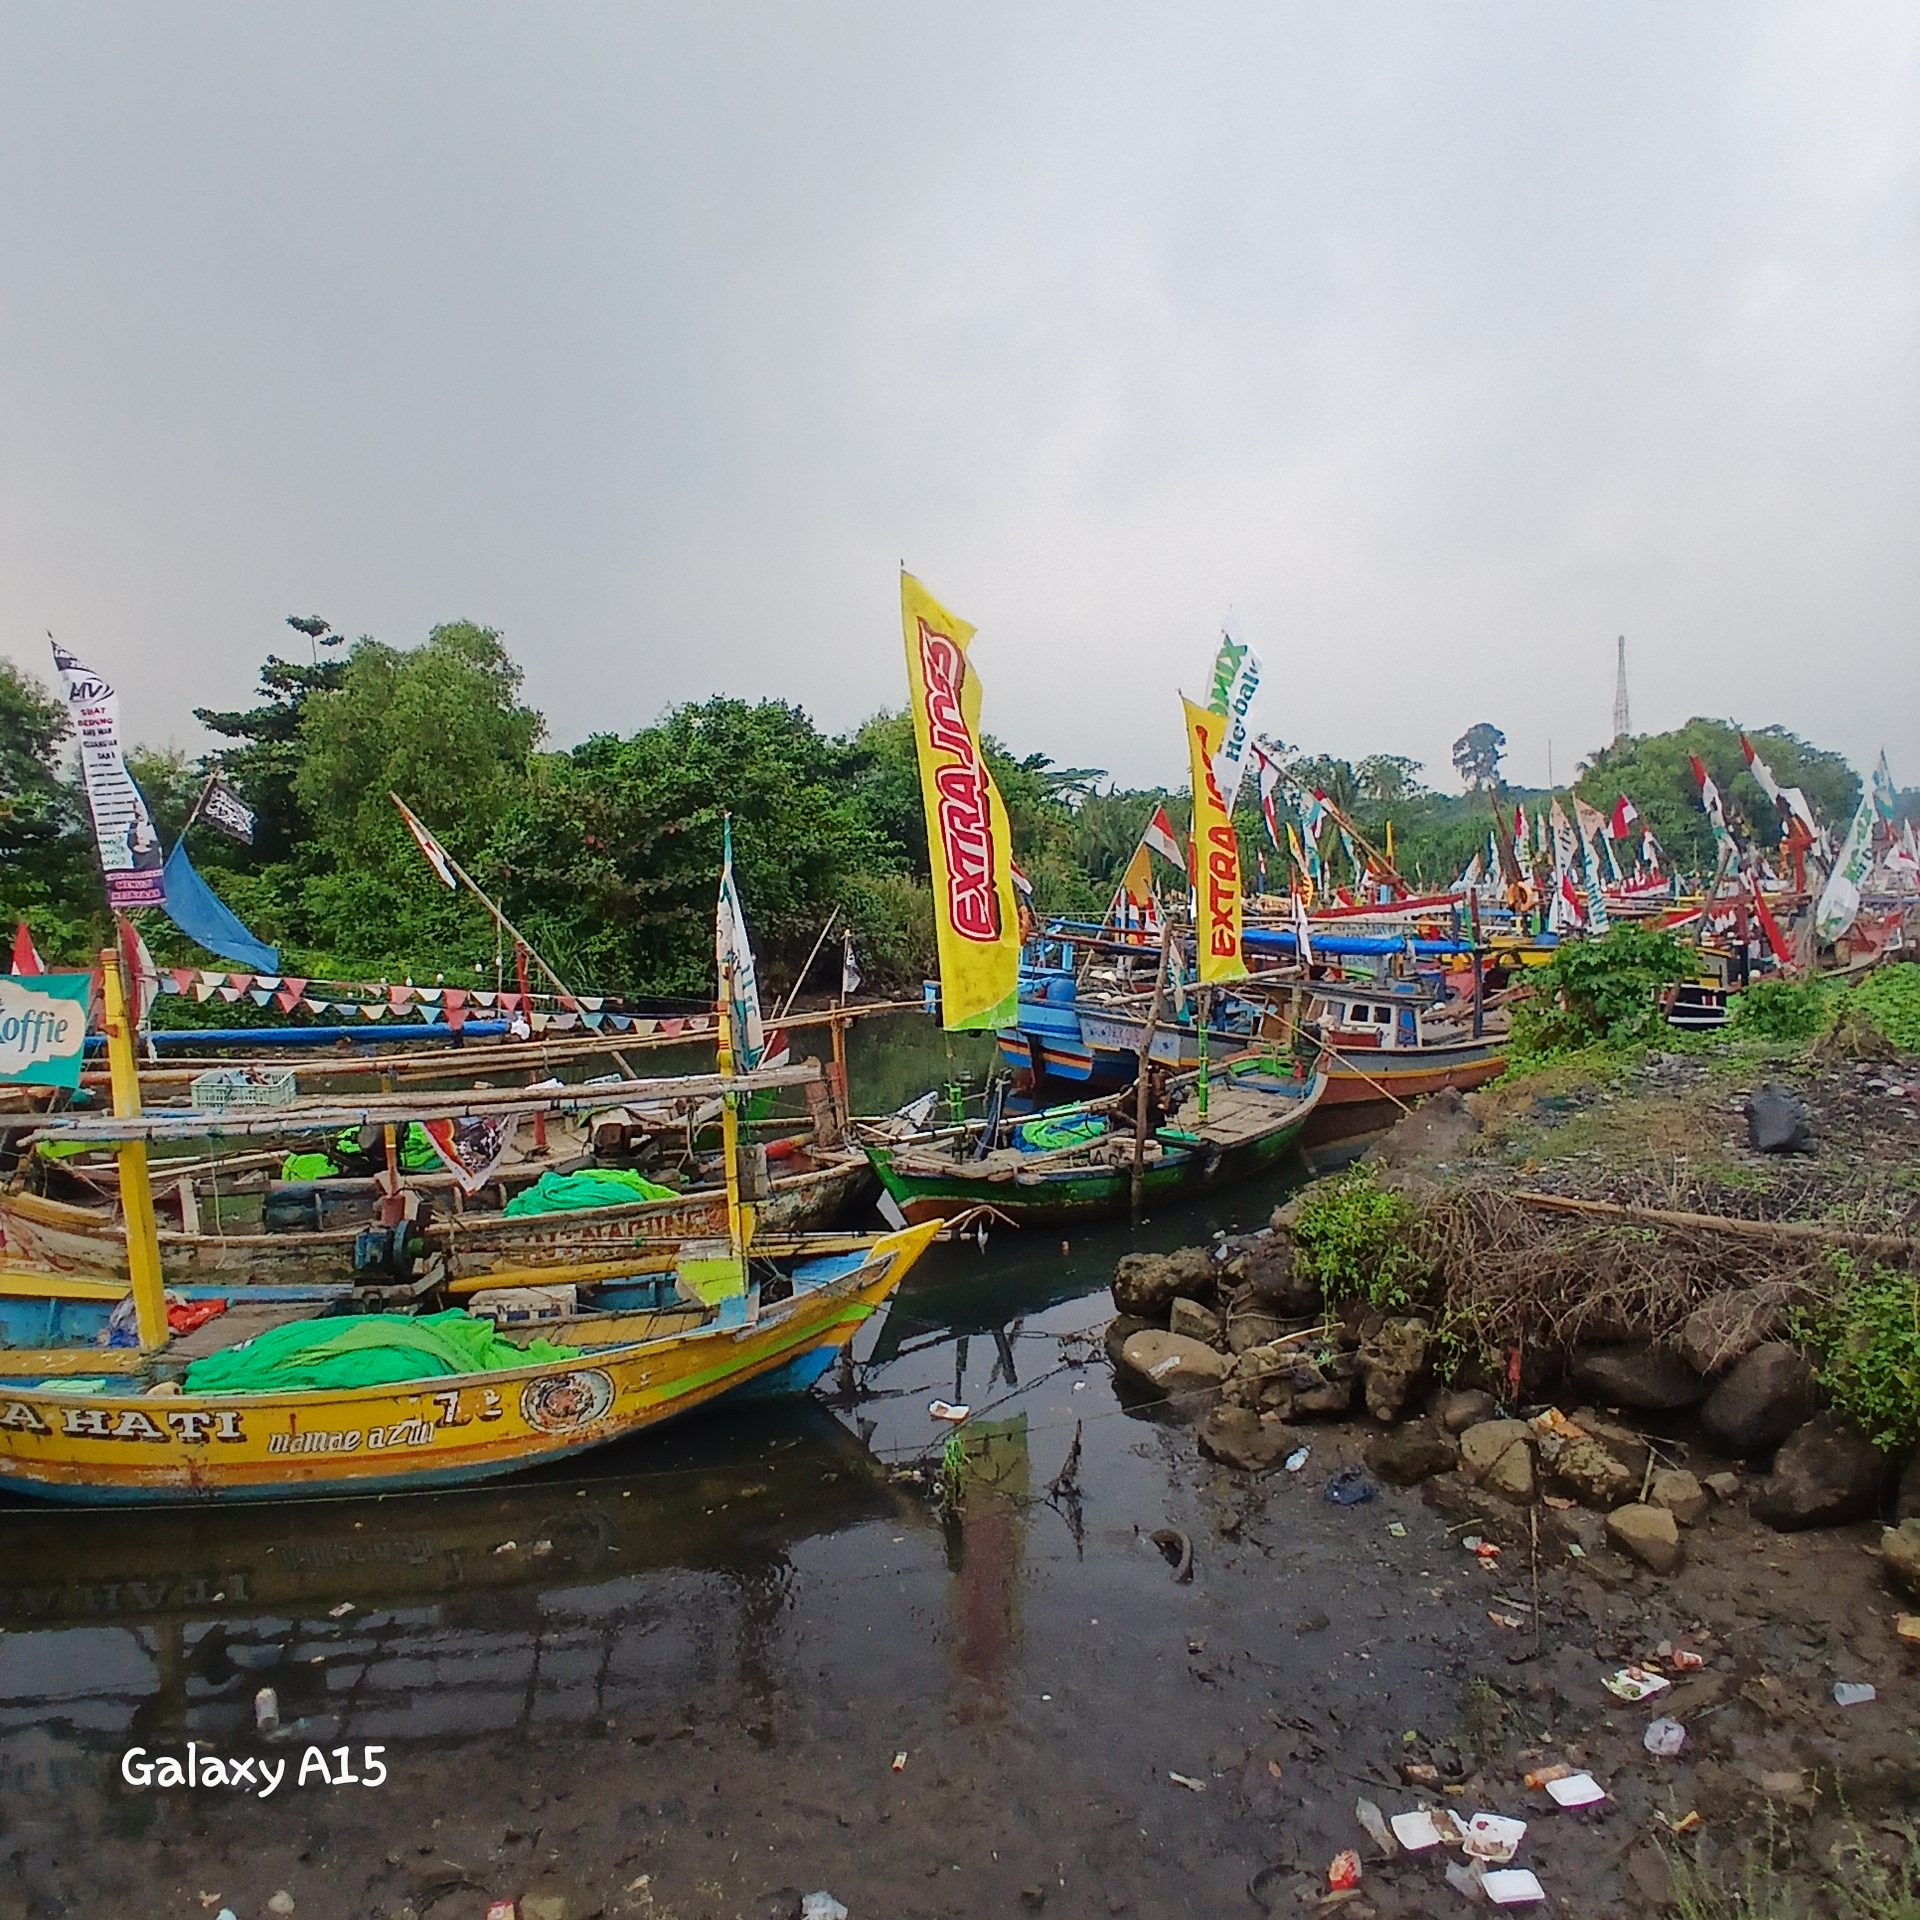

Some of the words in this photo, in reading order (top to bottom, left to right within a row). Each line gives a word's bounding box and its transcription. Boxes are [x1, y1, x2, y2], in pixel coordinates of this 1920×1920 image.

[935, 763, 1001, 942] EXTRA
[1207, 826, 1237, 957] EXTRA
[60, 1407, 246, 1442] HATI
